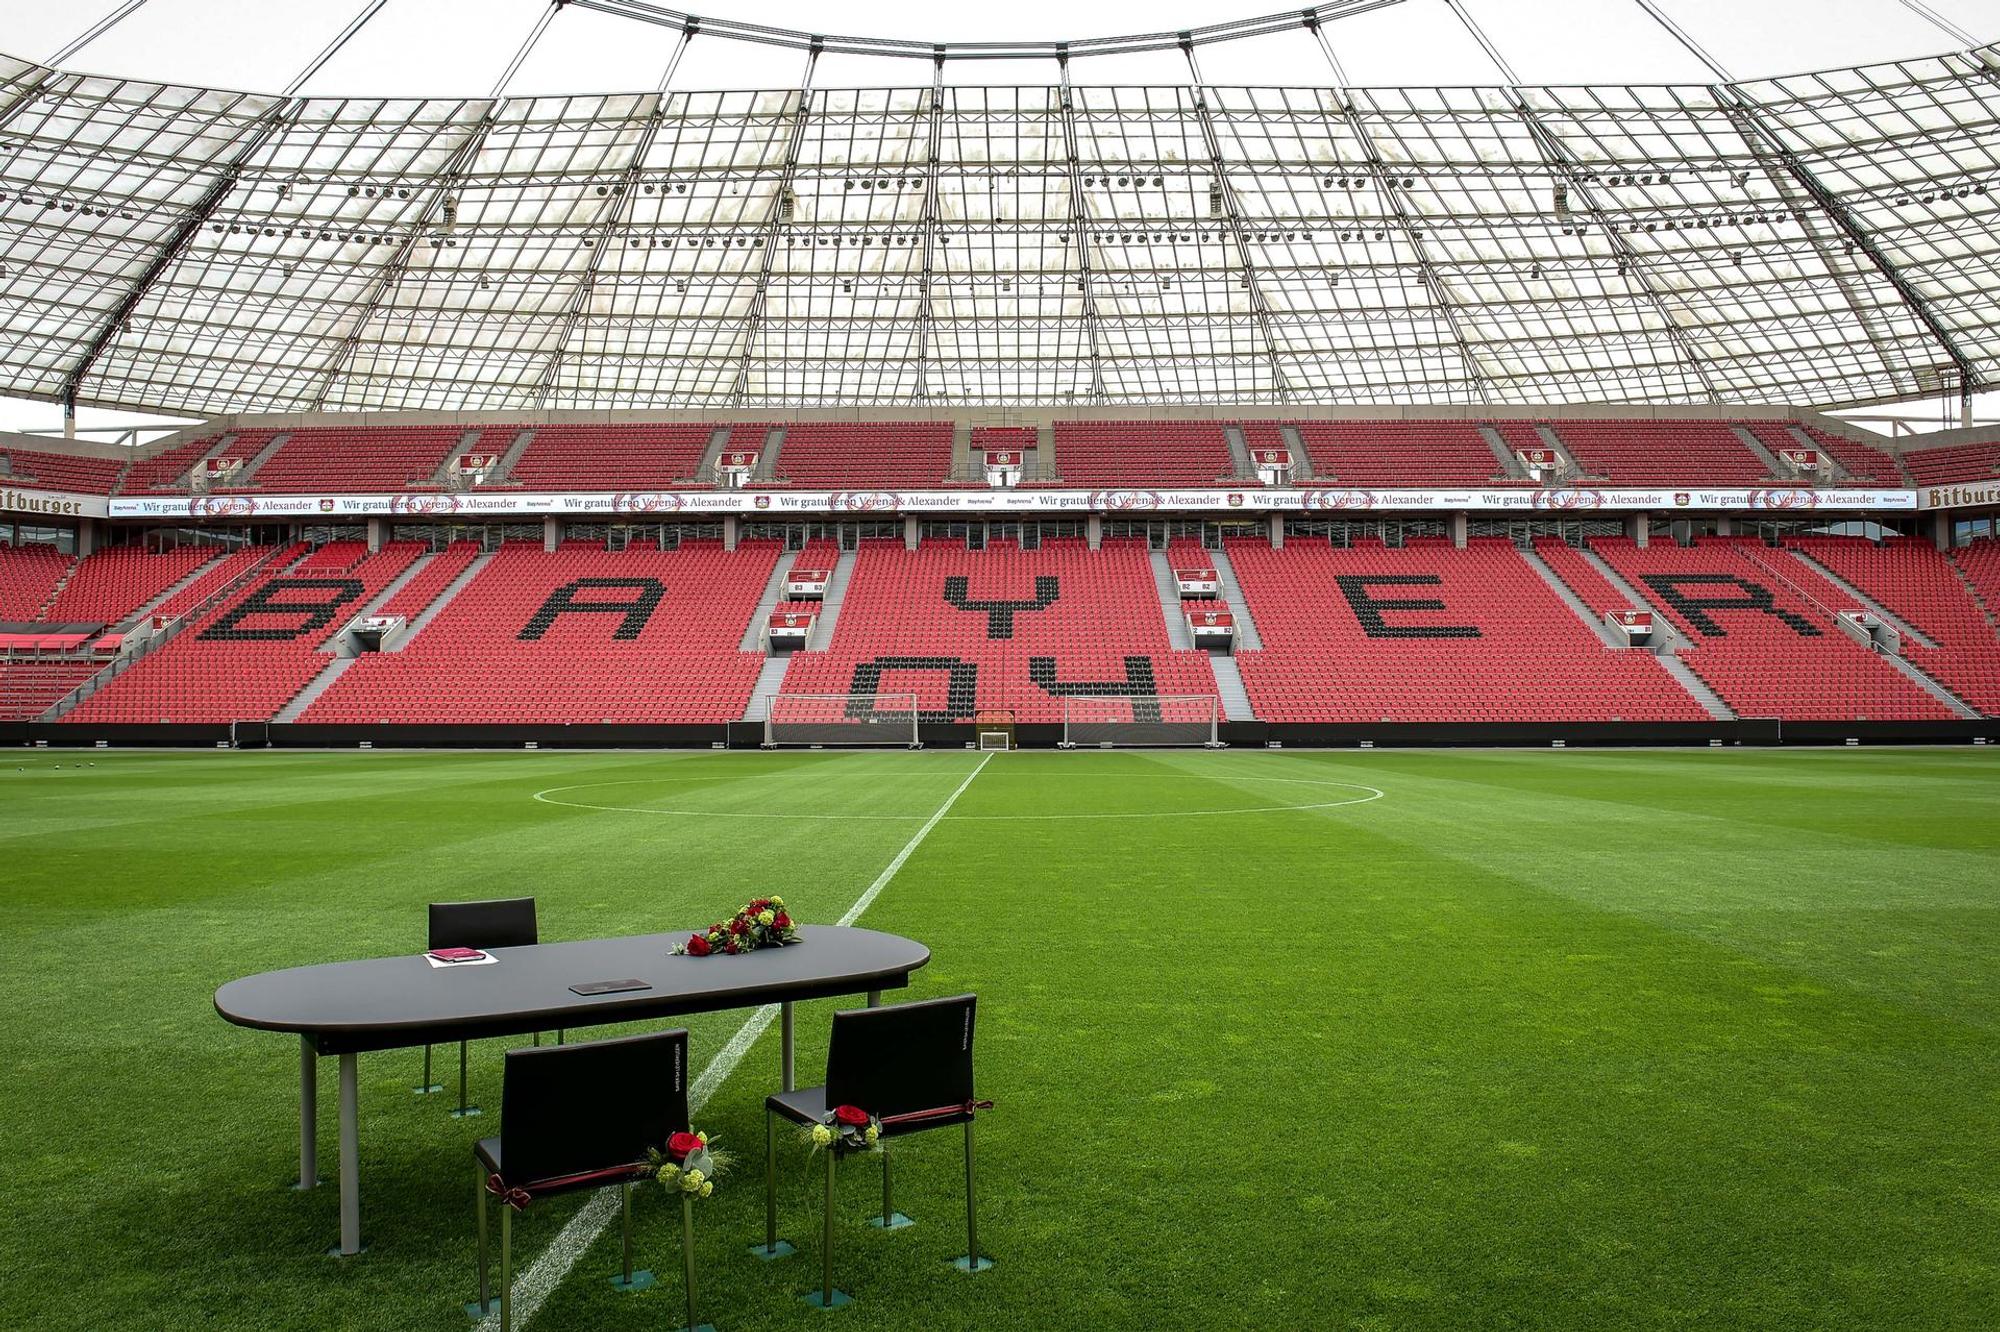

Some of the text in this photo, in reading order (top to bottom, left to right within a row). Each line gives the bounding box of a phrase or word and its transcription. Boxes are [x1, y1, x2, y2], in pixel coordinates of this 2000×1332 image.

[343, 499, 517, 512] Wir gratulieren Verena & Alexander
[564, 497, 742, 510] Wir gratulieren Verena & Alexander
[780, 496, 960, 509] Wir gratulieren Verena & Alexander
[1039, 495, 1220, 508] Wir gratulieren Verena & Alexander
[1252, 494, 1433, 508] Wir gratulieren Verena & Alexander
[1482, 494, 1661, 507] Wir gratulieren Verena & Alexander
[1700, 494, 1875, 506] Wir gratulieren Verena & Alexander
[143, 500, 312, 514] Wir gratulieren Verena & Alexander
[844, 656, 1162, 723] 04
